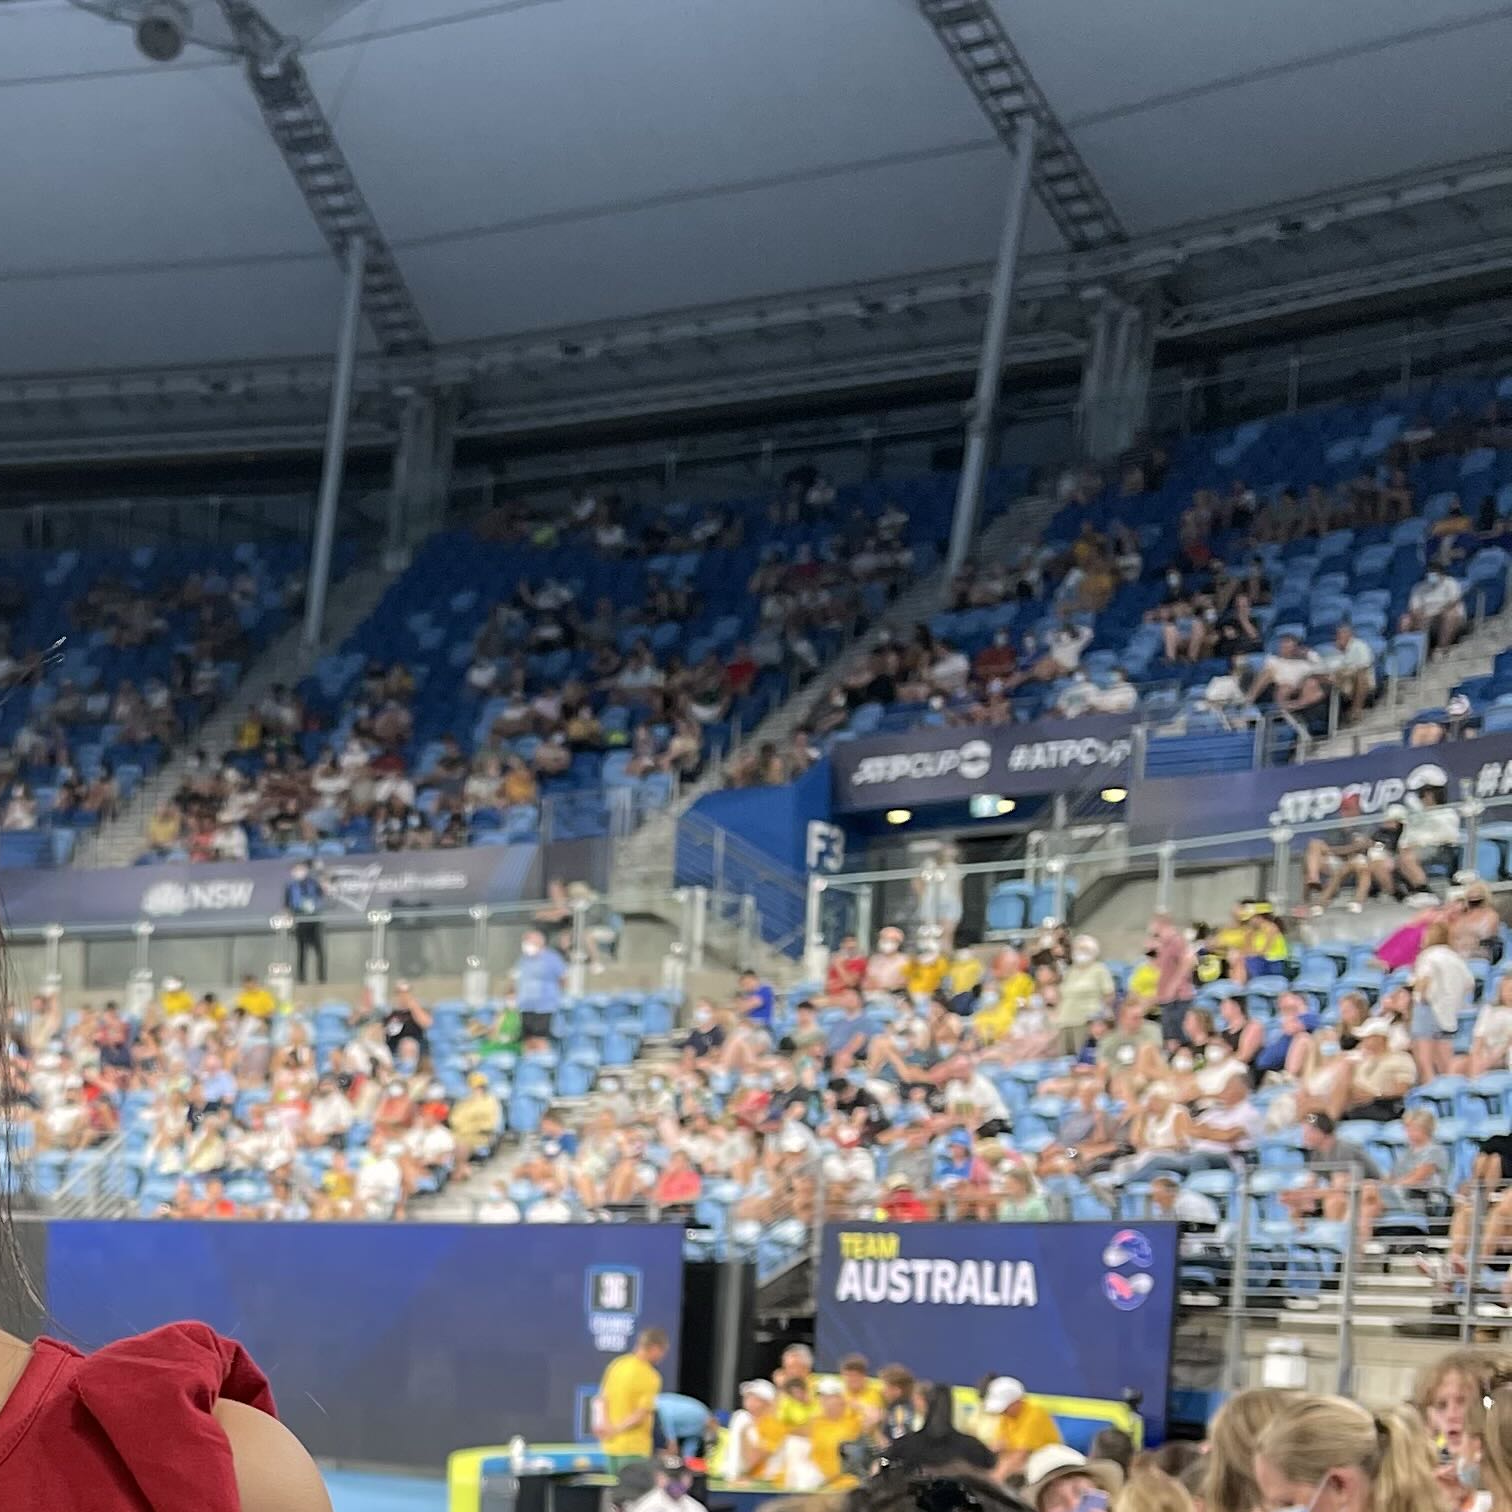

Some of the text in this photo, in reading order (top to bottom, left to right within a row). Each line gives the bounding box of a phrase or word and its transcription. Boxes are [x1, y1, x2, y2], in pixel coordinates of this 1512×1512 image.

[806, 820, 845, 873] F3
[190, 878, 254, 909] NSW
[838, 1231, 900, 1259] TEAM
[835, 1258, 1038, 1307] AUSTRALIA
